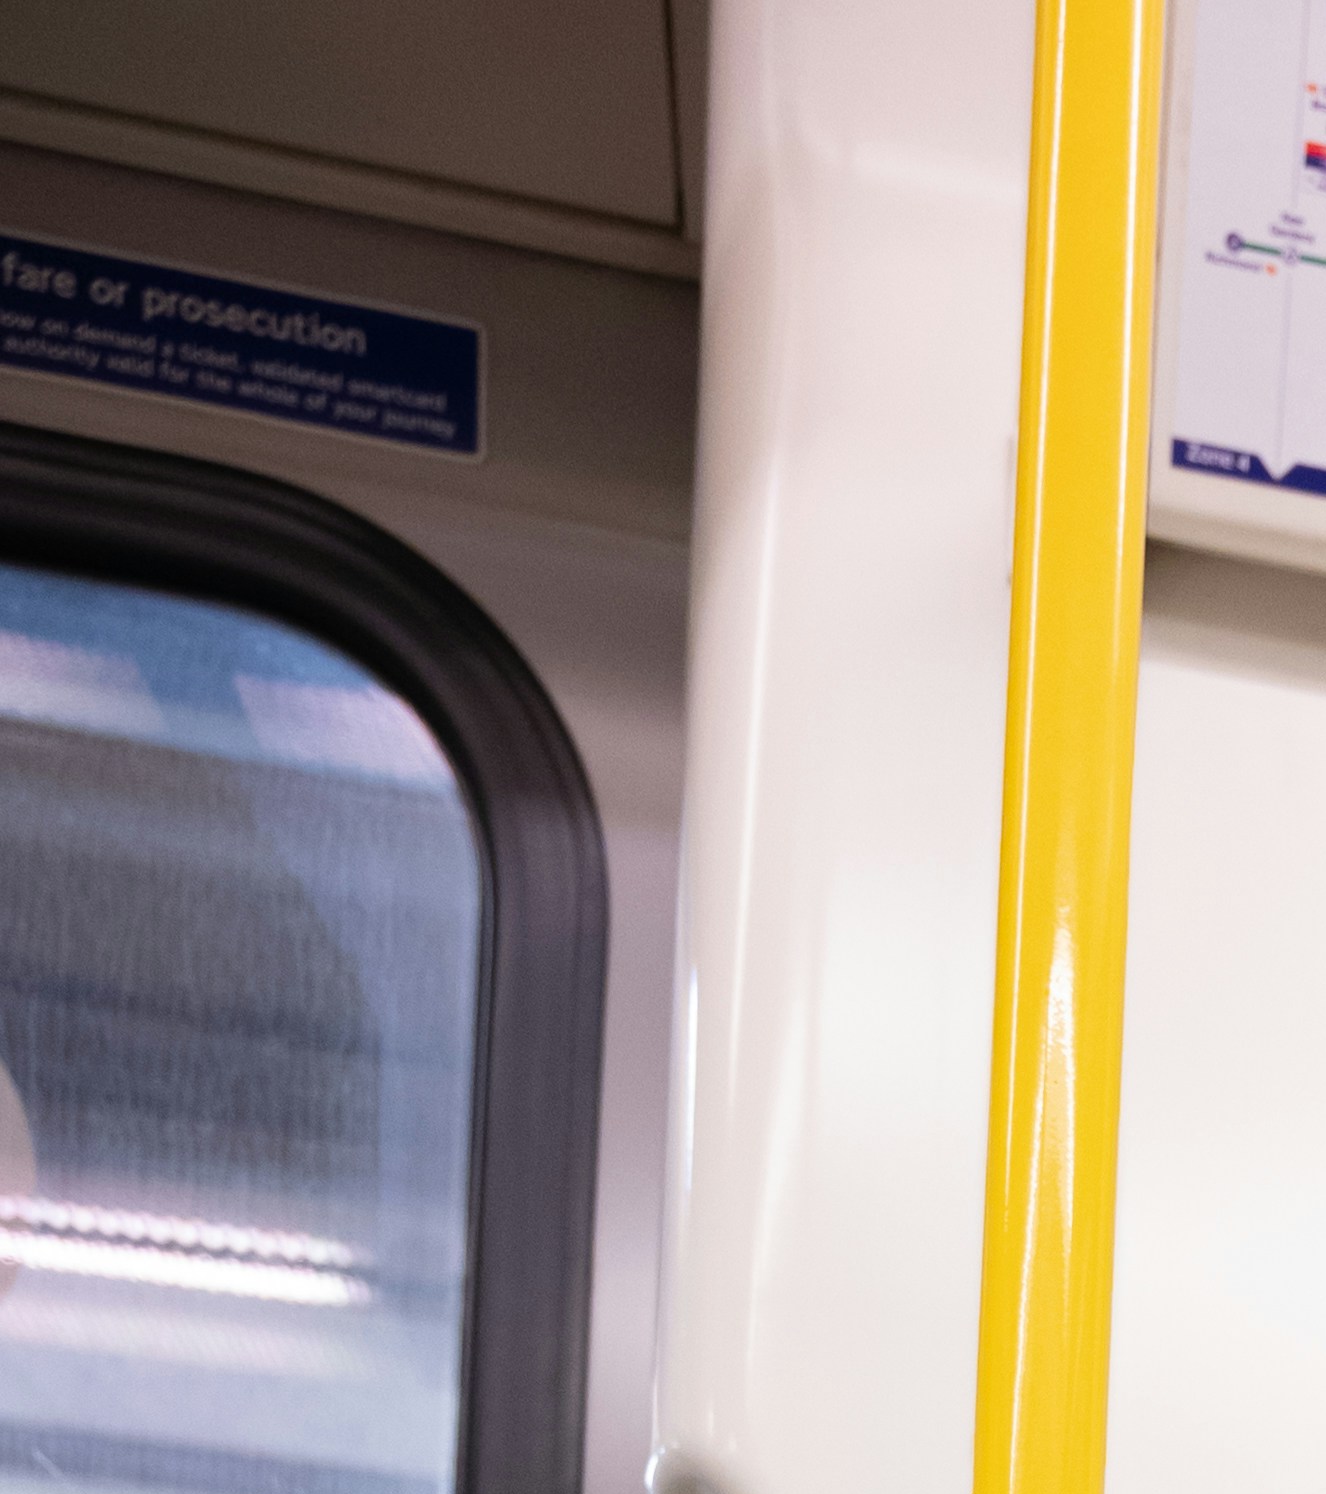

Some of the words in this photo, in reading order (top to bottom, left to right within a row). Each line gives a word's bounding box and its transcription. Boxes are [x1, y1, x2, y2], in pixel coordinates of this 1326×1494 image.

[2, 251, 78, 299] fare
[88, 277, 129, 307] or
[141, 287, 368, 357] prosecution
[1186, 442, 1235, 471] Zone
